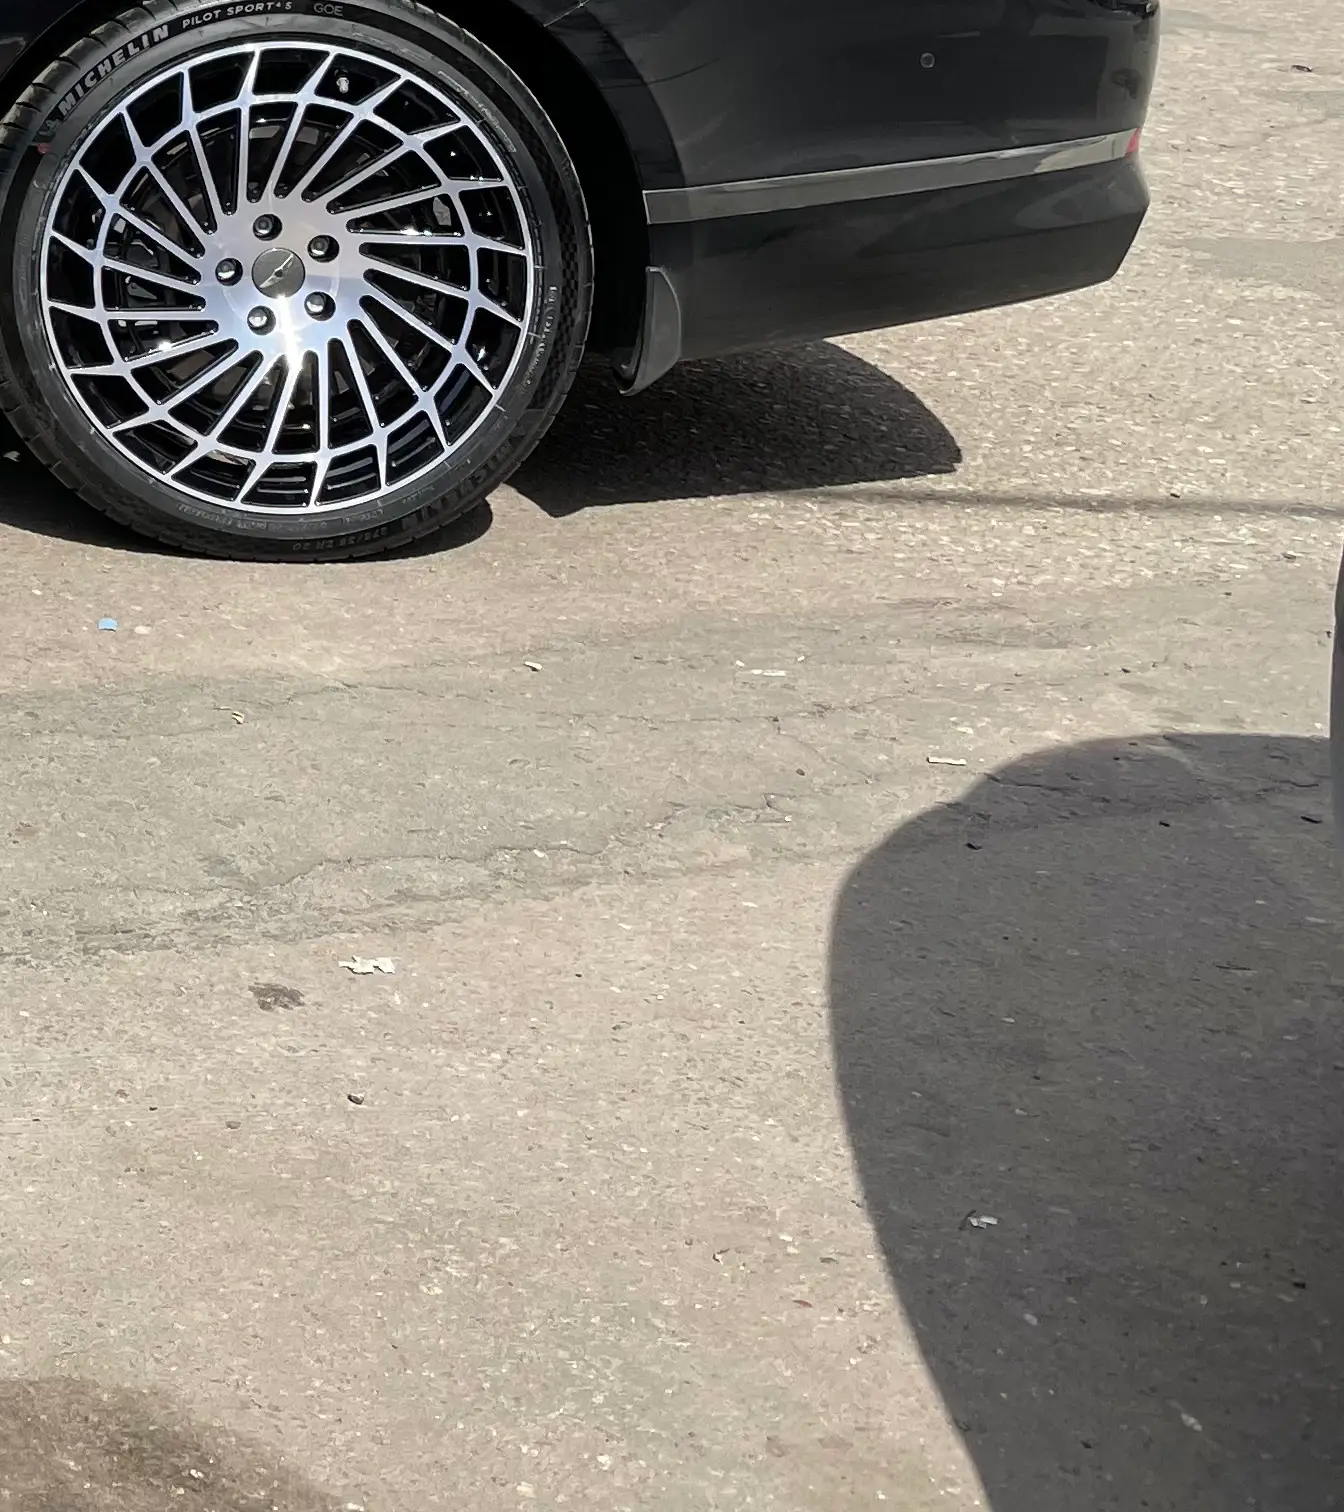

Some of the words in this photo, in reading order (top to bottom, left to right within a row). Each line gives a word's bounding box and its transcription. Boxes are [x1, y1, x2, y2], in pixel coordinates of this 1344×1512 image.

[60, 24, 169, 116] MICHELIN
[182, 10, 221, 29] PILOT
[313, 2, 344, 16] GOE
